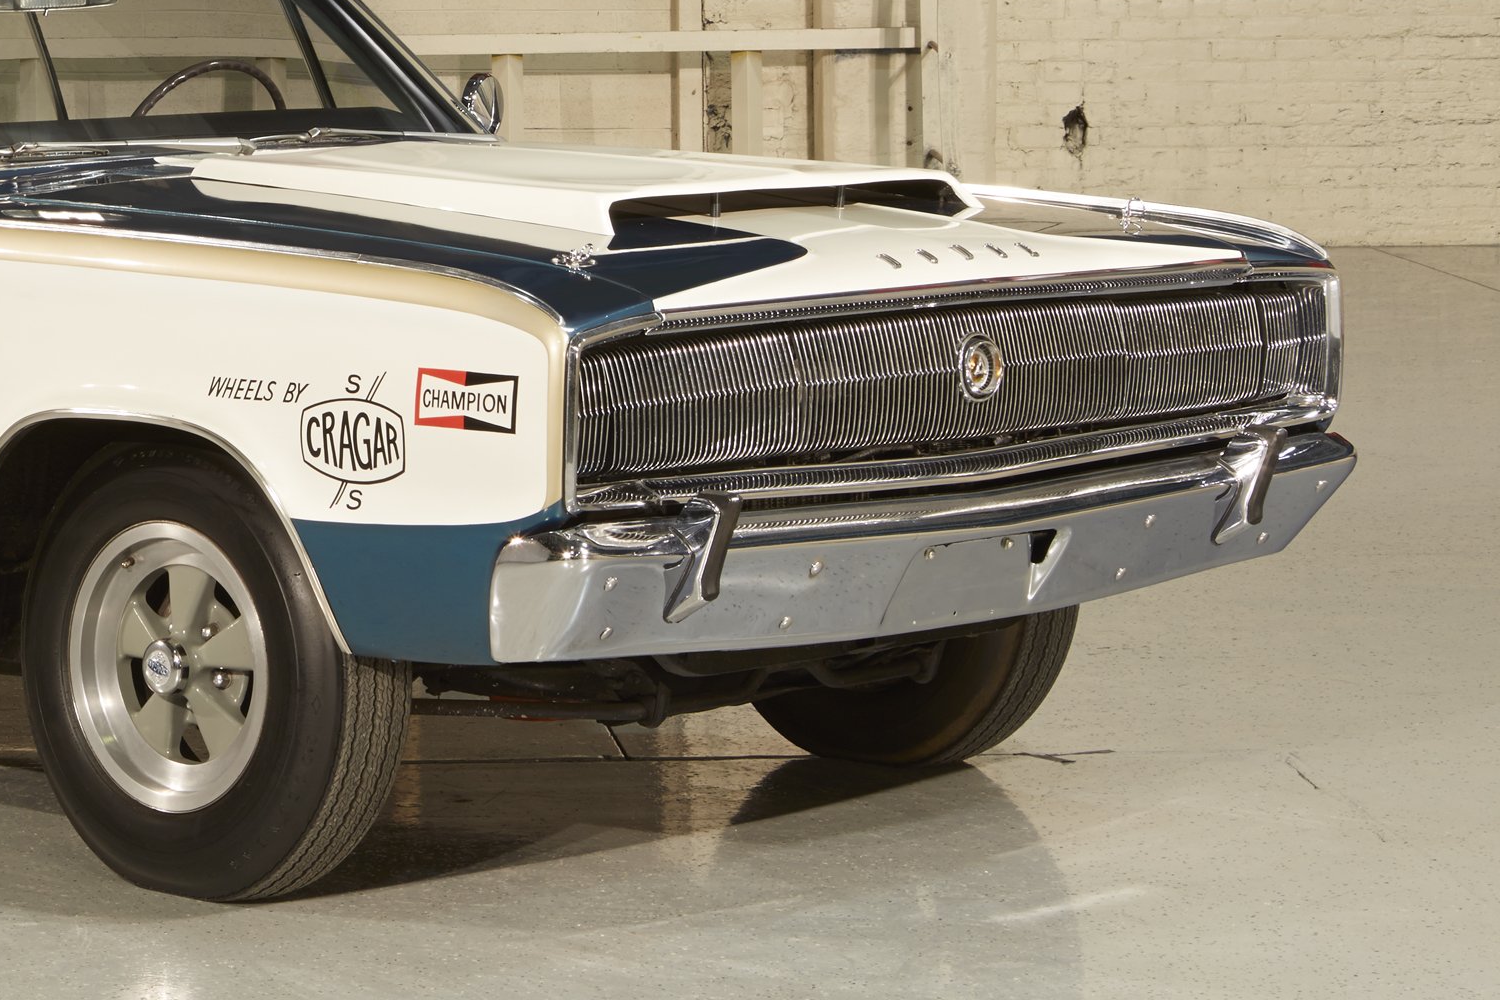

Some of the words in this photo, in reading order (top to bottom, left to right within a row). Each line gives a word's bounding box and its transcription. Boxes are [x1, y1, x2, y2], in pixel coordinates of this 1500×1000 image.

[207, 375, 277, 402] WHEELS
[283, 382, 310, 403] BY
[422, 388, 508, 414] CHAMPION
[306, 410, 400, 472] CRAGAR
